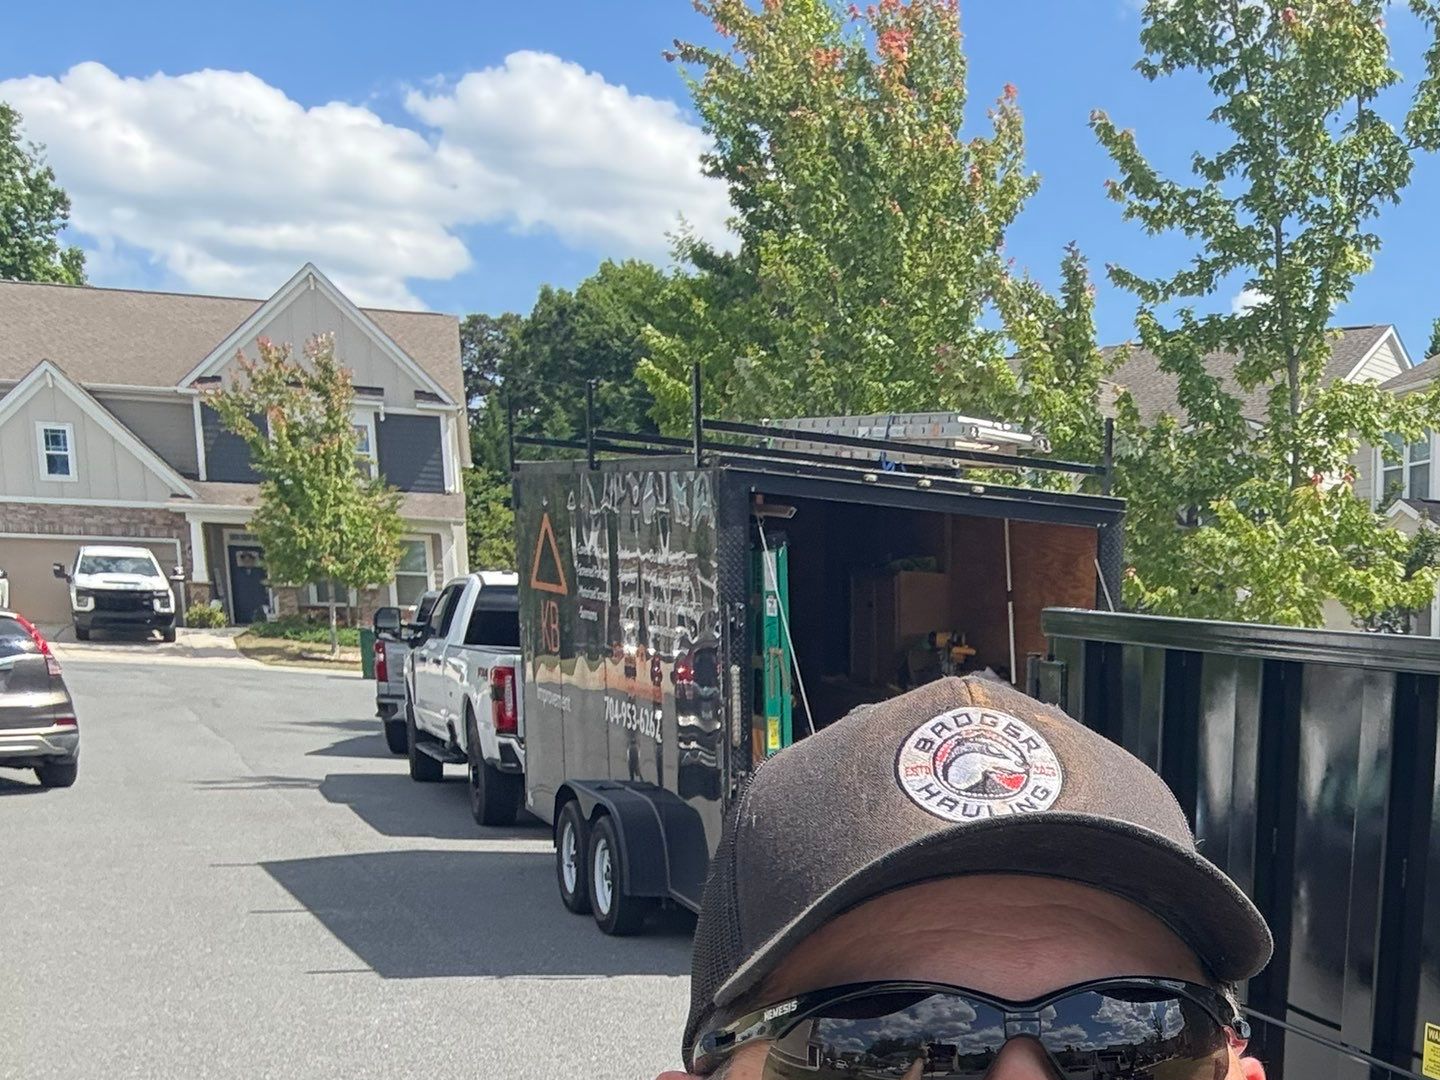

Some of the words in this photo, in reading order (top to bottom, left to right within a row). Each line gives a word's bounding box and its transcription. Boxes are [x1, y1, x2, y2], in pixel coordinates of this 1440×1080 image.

[540, 599, 561, 654] KB
[915, 712, 1041, 754] BADGER
[764, 1000, 798, 1022] NEMESIS
